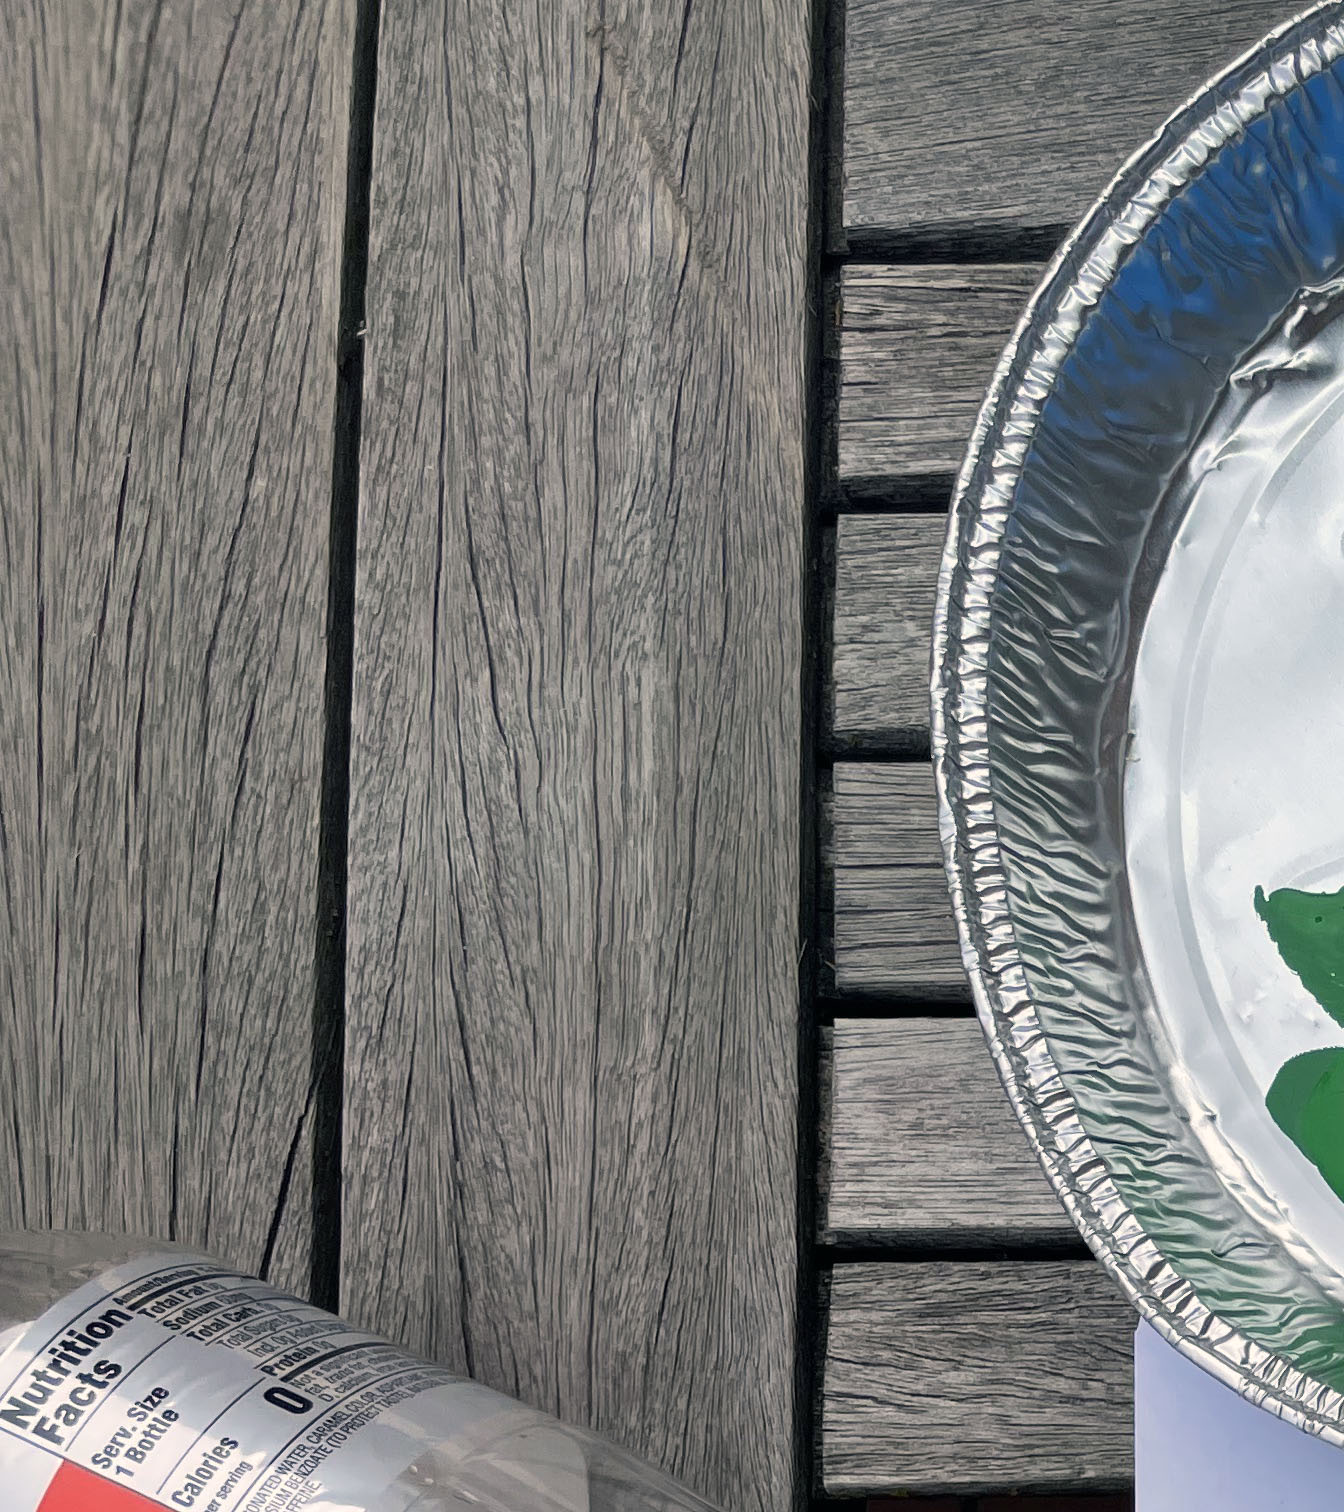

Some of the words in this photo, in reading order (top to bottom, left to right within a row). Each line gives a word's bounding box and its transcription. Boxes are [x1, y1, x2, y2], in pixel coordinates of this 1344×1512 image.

[137, 1294, 185, 1319] Total
[176, 1284, 210, 1299] Fat
[163, 1301, 223, 1331] Sodium
[186, 1318, 229, 1341] Total
[216, 1329, 253, 1349] Total
[0, 1308, 134, 1430] Nutrition
[260, 1345, 320, 1376] Protein
[290, 1373, 316, 1389] Not
[32, 1360, 122, 1446] Facts
[91, 1426, 138, 1470] Serv.
[127, 1386, 170, 1423] Size
[124, 1409, 180, 1465] Bottle
[171, 1437, 239, 1508] Calories
[263, 1386, 314, 1415] 0
[275, 1442, 314, 1476] WATER,
[305, 1409, 354, 1444] CARAMEL
[287, 1444, 334, 1490] BENZOATE
[326, 1431, 349, 1450] (TO
[340, 1405, 385, 1440] PROTECT
[115, 1464, 135, 1478] 1
[216, 1461, 254, 1500] serving
